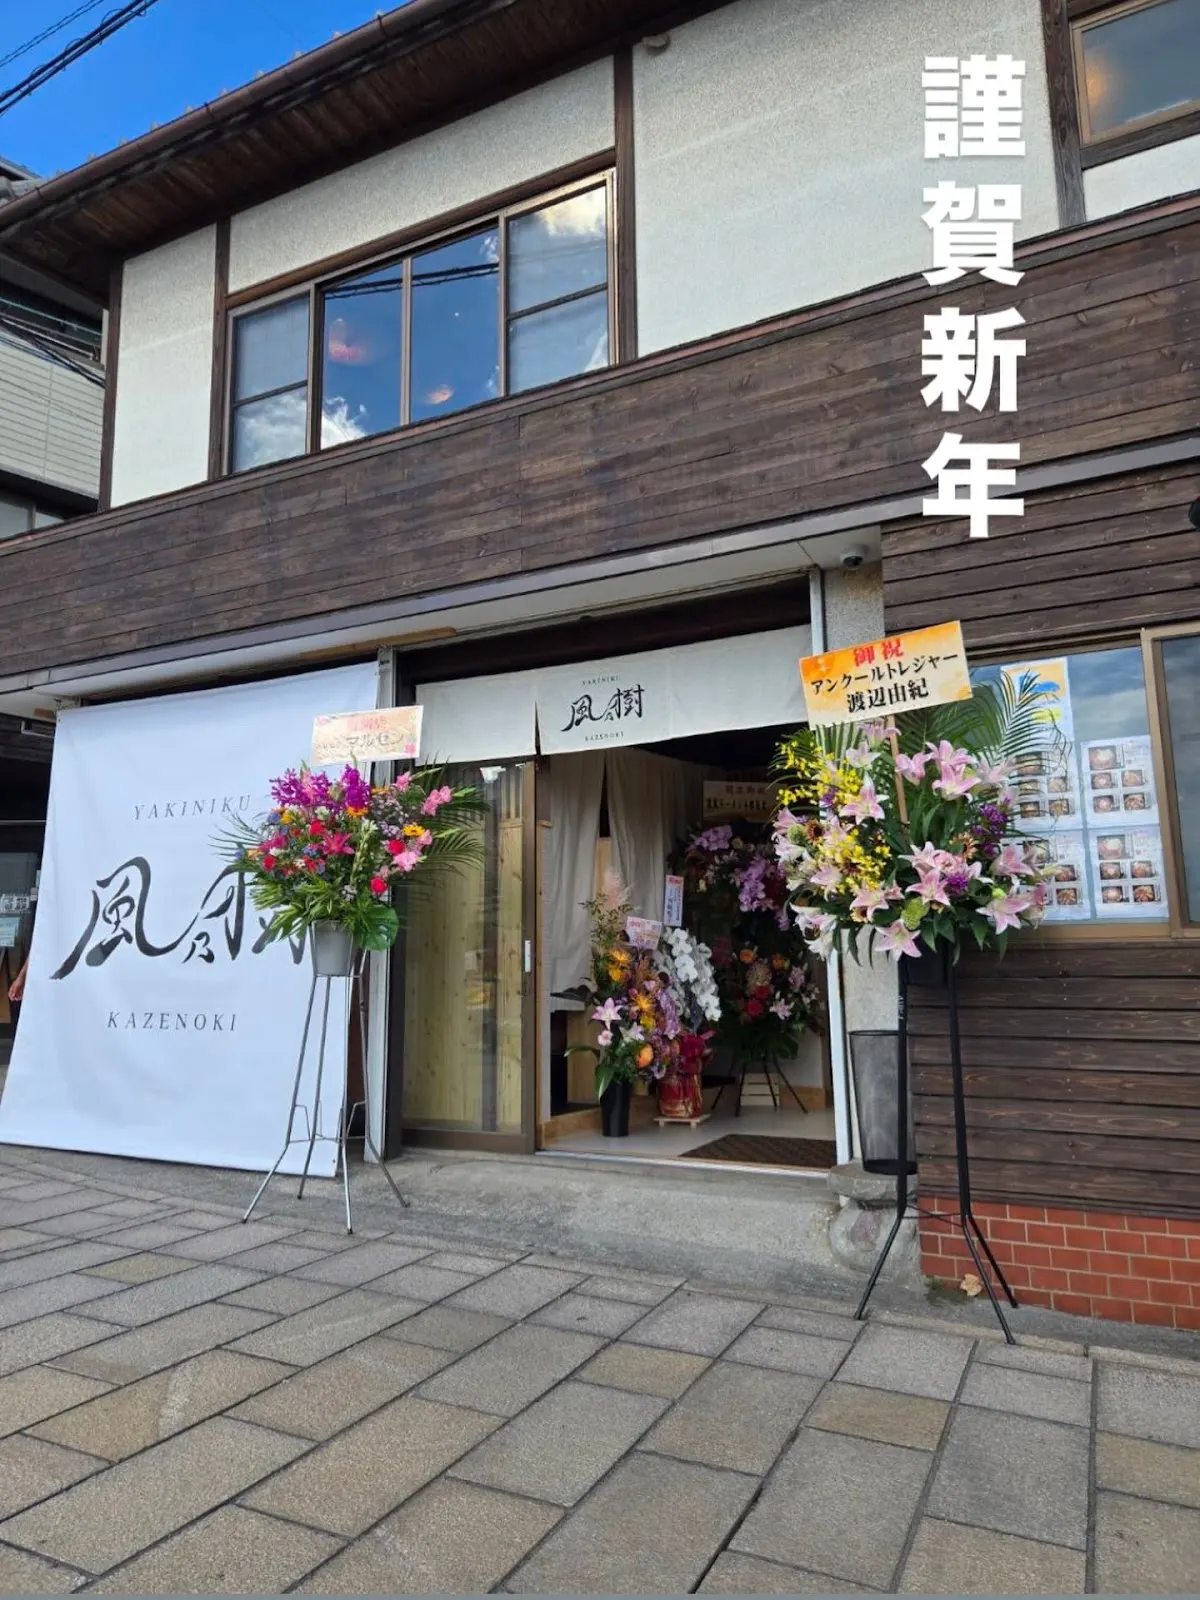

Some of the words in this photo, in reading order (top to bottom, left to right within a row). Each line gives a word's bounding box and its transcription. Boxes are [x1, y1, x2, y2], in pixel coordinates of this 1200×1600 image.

[852, 640, 904, 667] 御祝
[811, 653, 958, 695] アンクールトレジャー
[847, 677, 929, 713] 渡辺由紀
[134, 795, 251, 820] YAKINIKU
[106, 1010, 236, 1031] KAZENOKI
